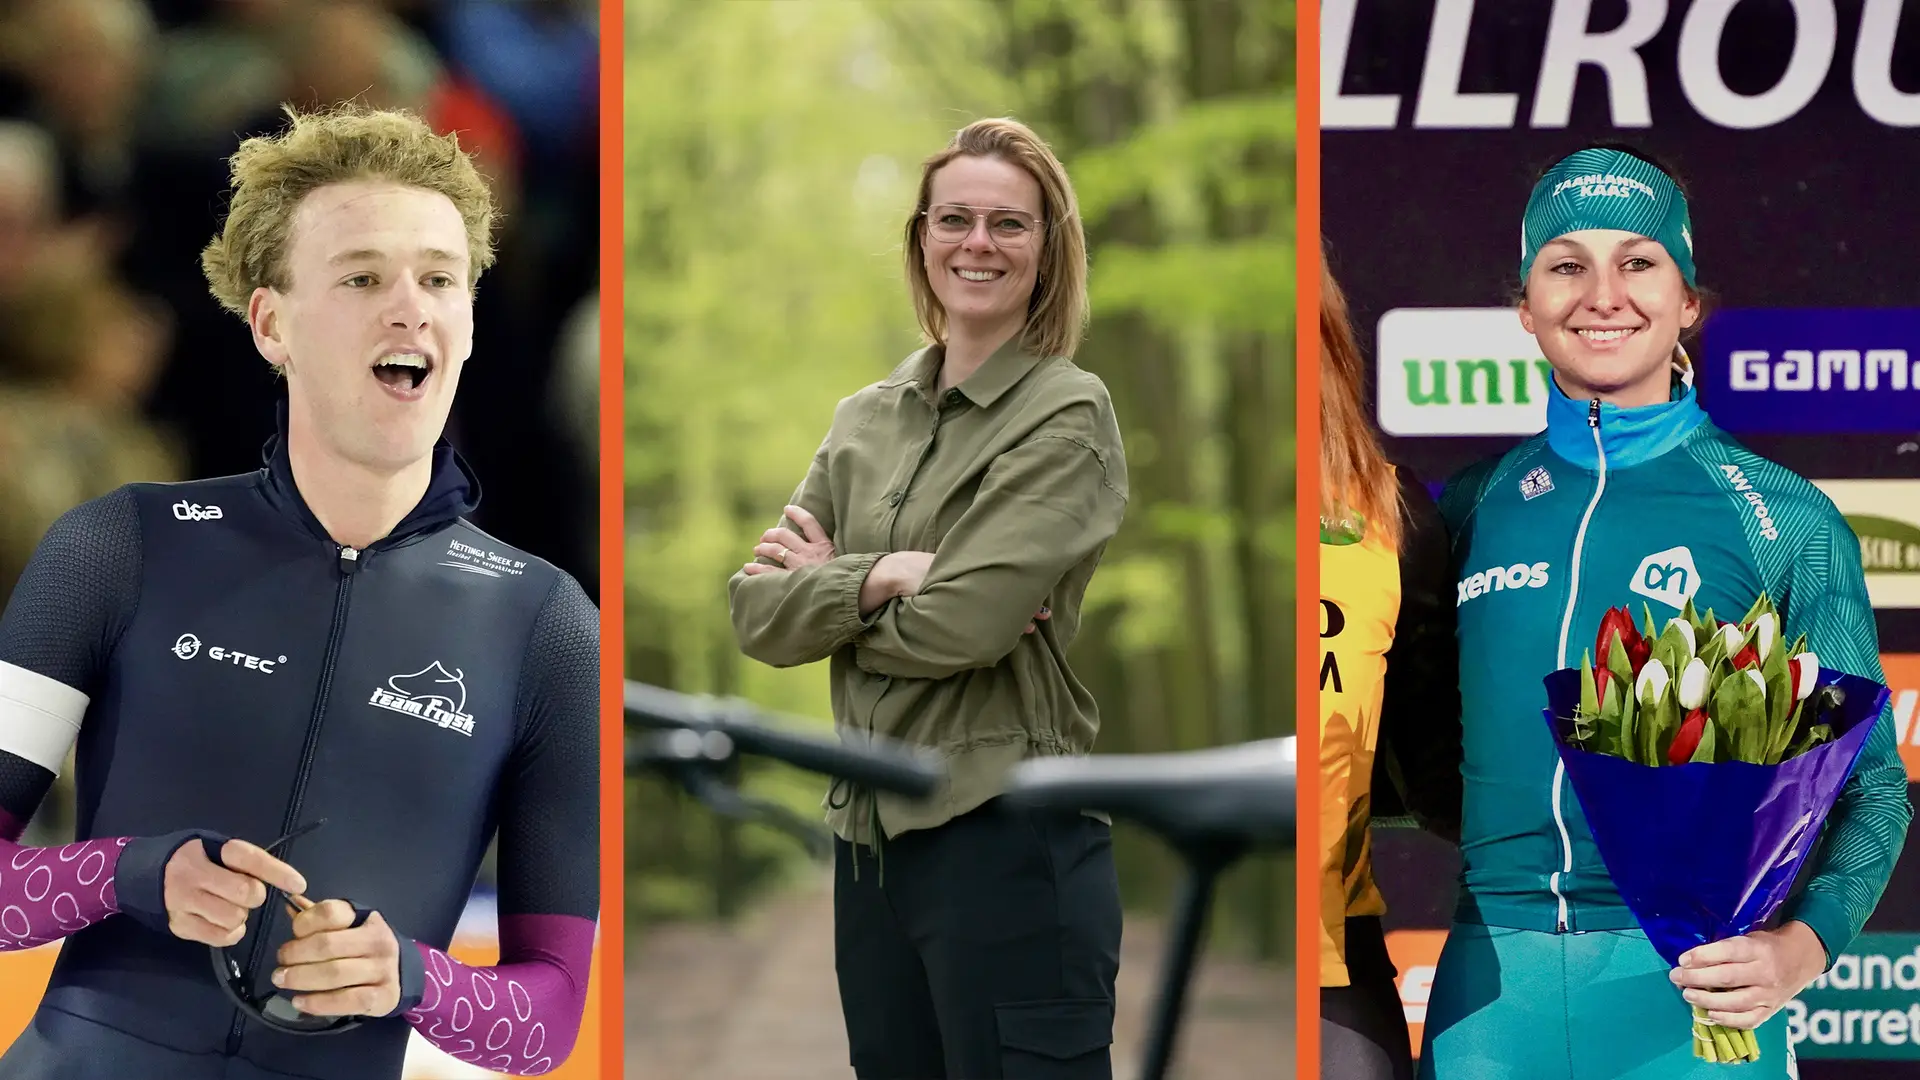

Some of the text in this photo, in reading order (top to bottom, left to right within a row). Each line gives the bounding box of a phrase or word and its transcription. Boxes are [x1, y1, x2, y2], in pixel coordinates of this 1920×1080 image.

[1553, 173, 1655, 201] ZAANLANDER
[1580, 184, 1630, 198] KAAS
[1720, 464, 1753, 492] AW
[450, 539, 485, 559] HETTINGA
[514, 561, 527, 569] BV
[1457, 562, 1550, 607] xenos
[369, 687, 423, 715] team
[1805, 944, 1920, 990] and
